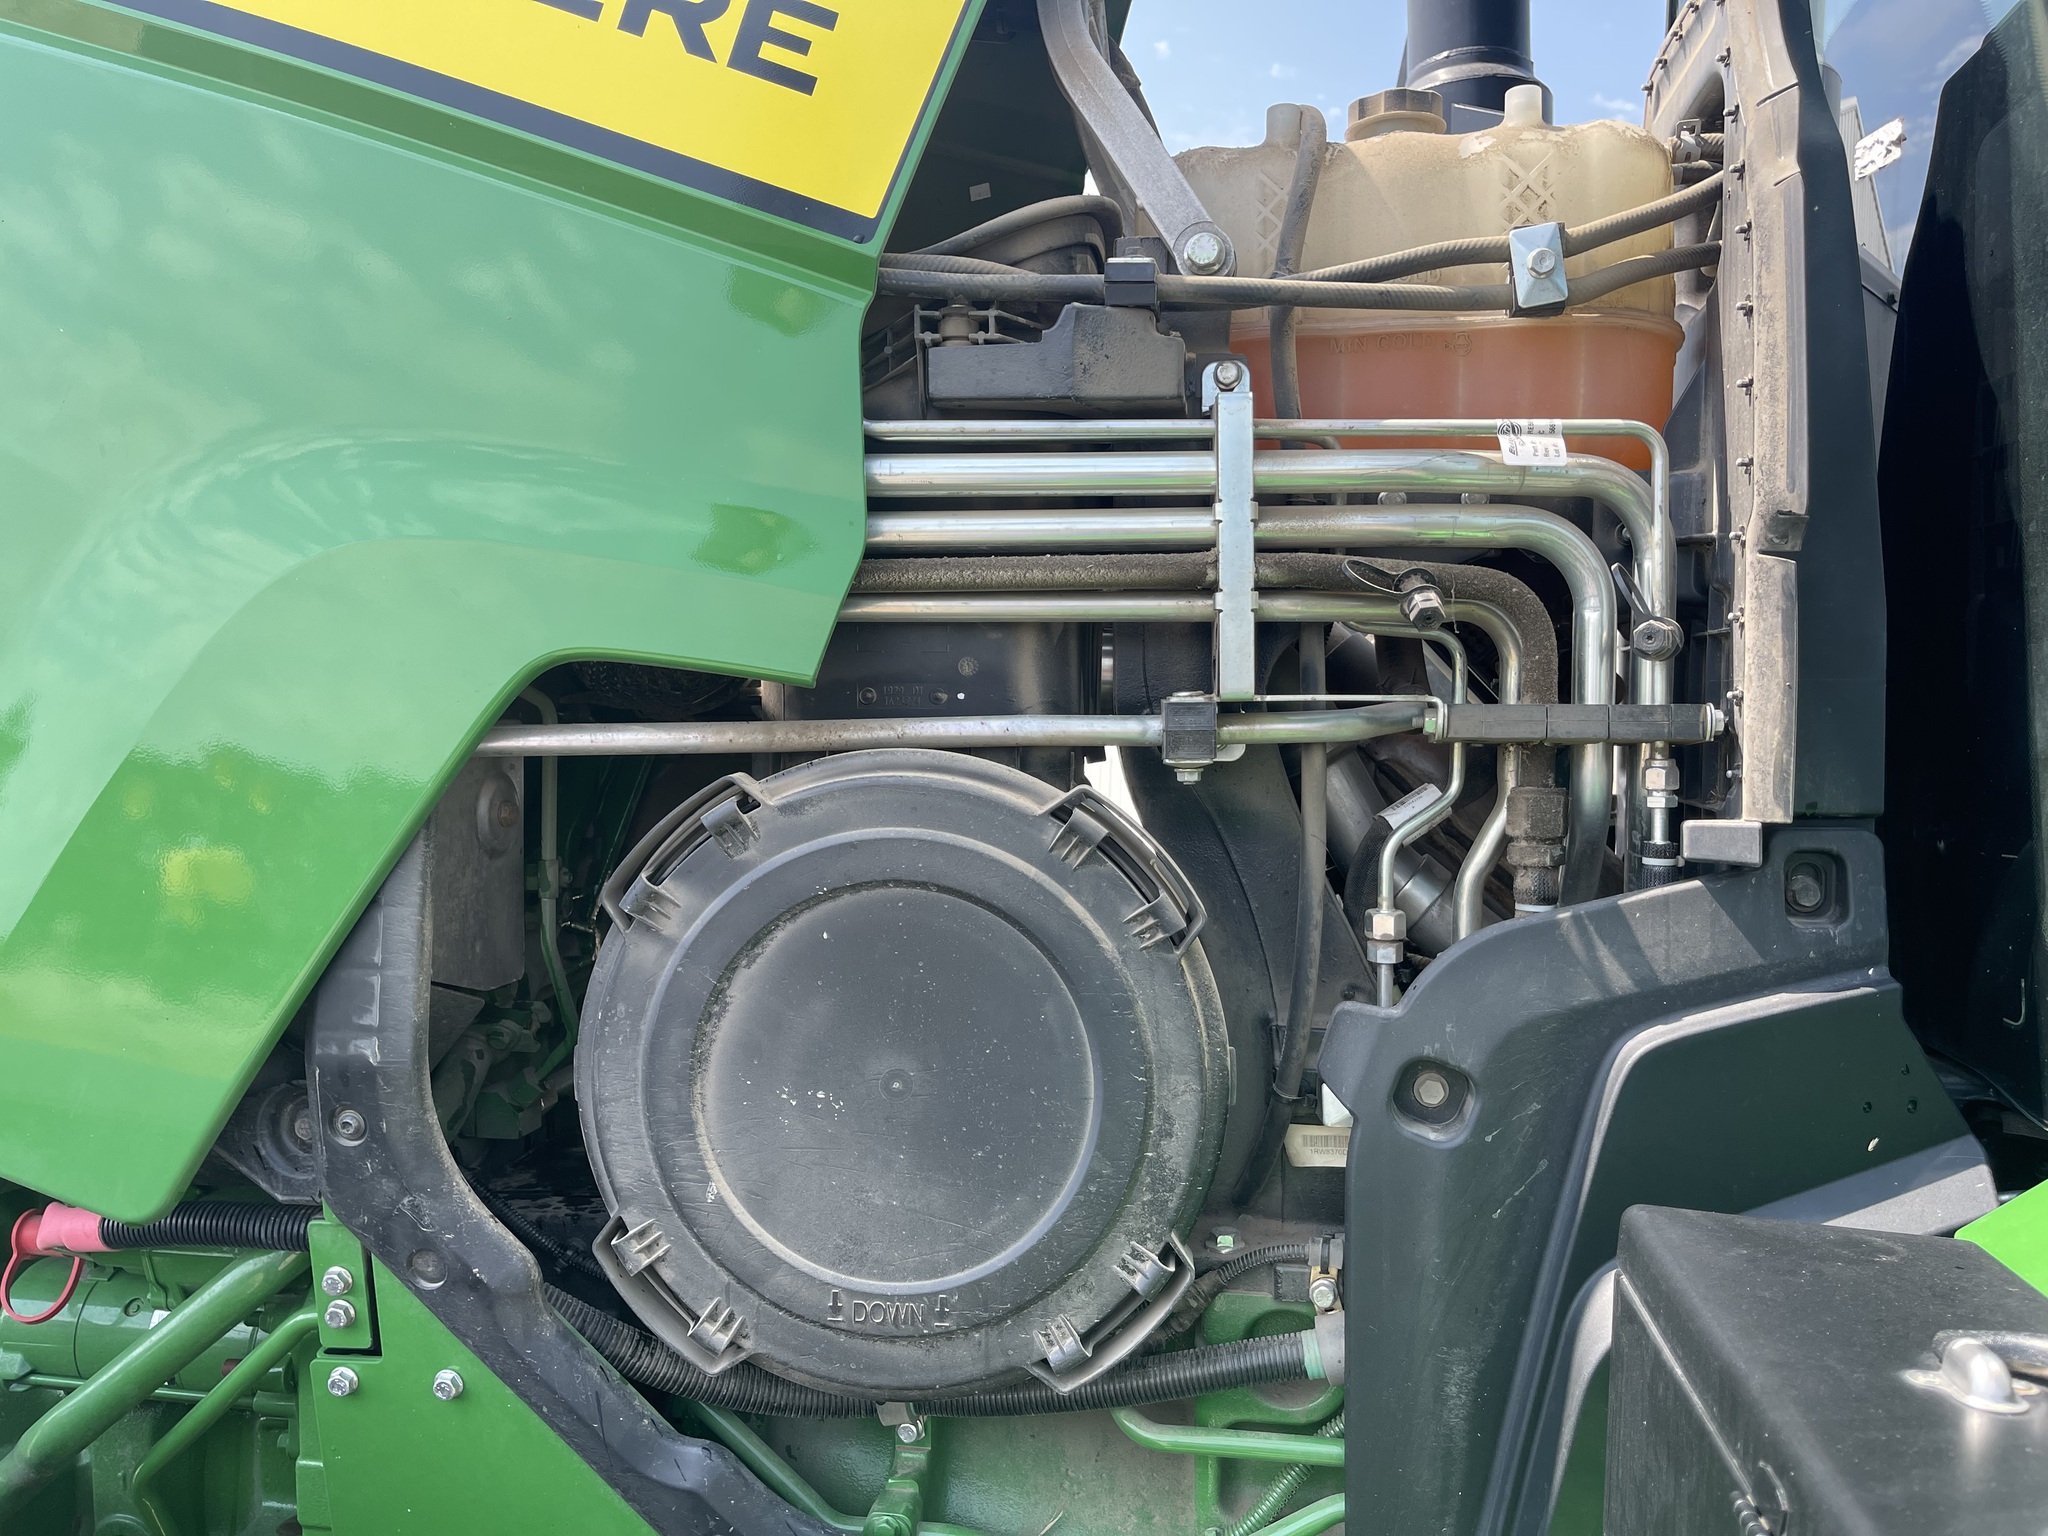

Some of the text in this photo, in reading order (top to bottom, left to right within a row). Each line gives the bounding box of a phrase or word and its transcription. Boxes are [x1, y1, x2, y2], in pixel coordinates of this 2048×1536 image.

[532, 0, 840, 97] RE
[1329, 333, 1436, 354] MIN COLD
[852, 1300, 924, 1325] DOWN
